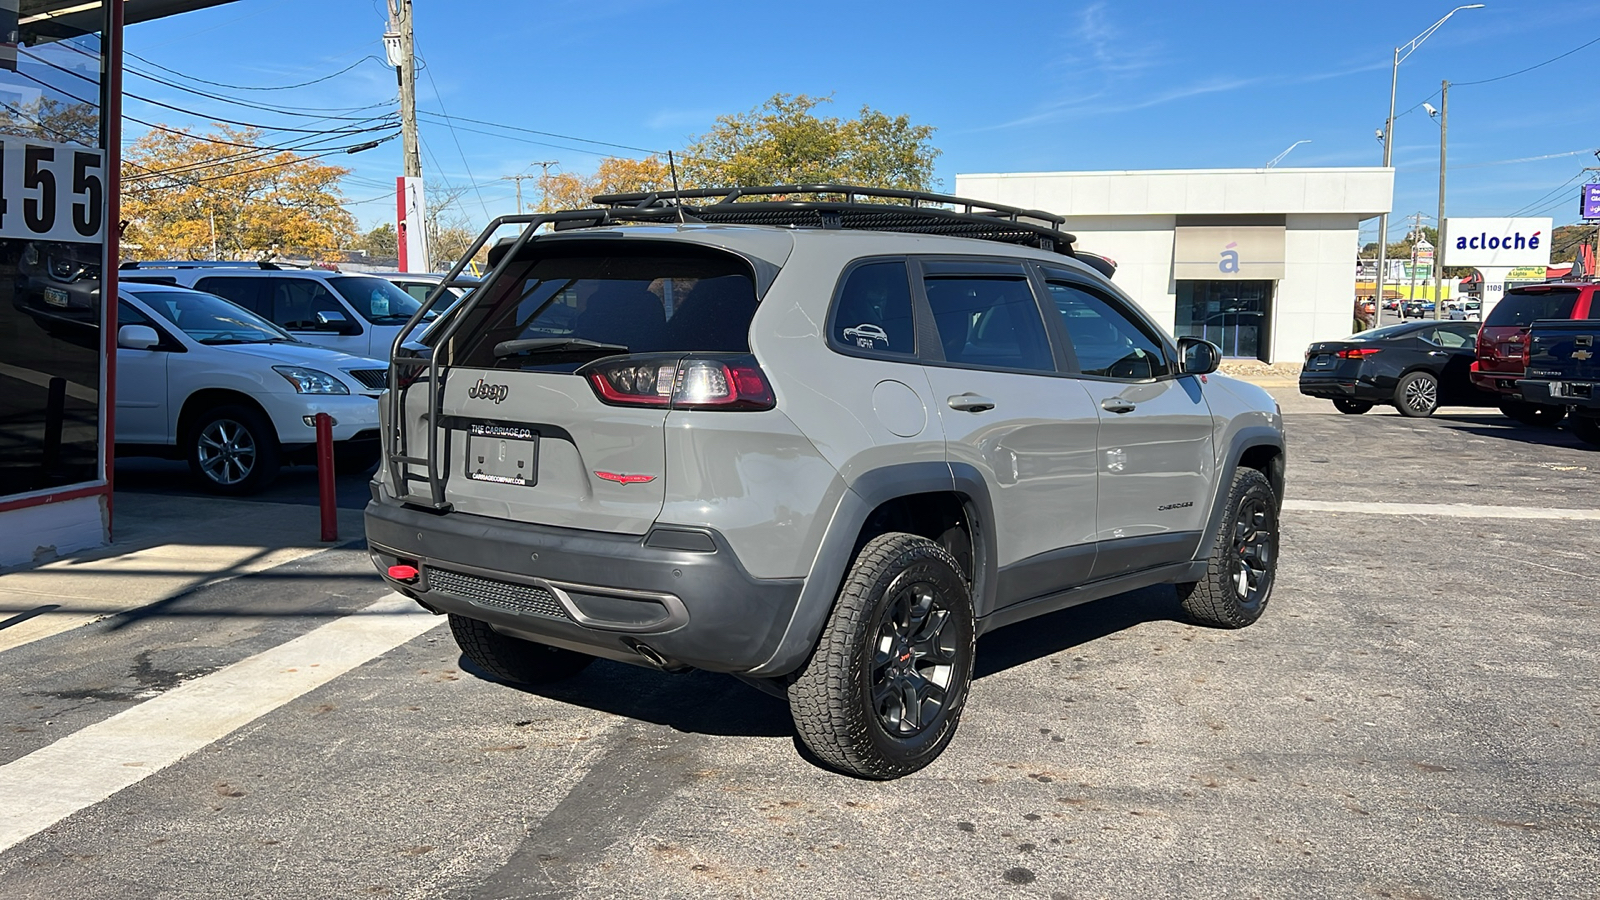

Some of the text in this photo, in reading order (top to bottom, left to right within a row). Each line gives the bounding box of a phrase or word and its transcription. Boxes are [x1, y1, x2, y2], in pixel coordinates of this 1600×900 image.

[0, 140, 103, 237] 55
[1456, 231, 1541, 250] acloché
[1219, 241, 1240, 274] á
[468, 379, 509, 404] Jeep
[471, 424, 484, 435] THE
[485, 425, 518, 437] CARRIAGE
